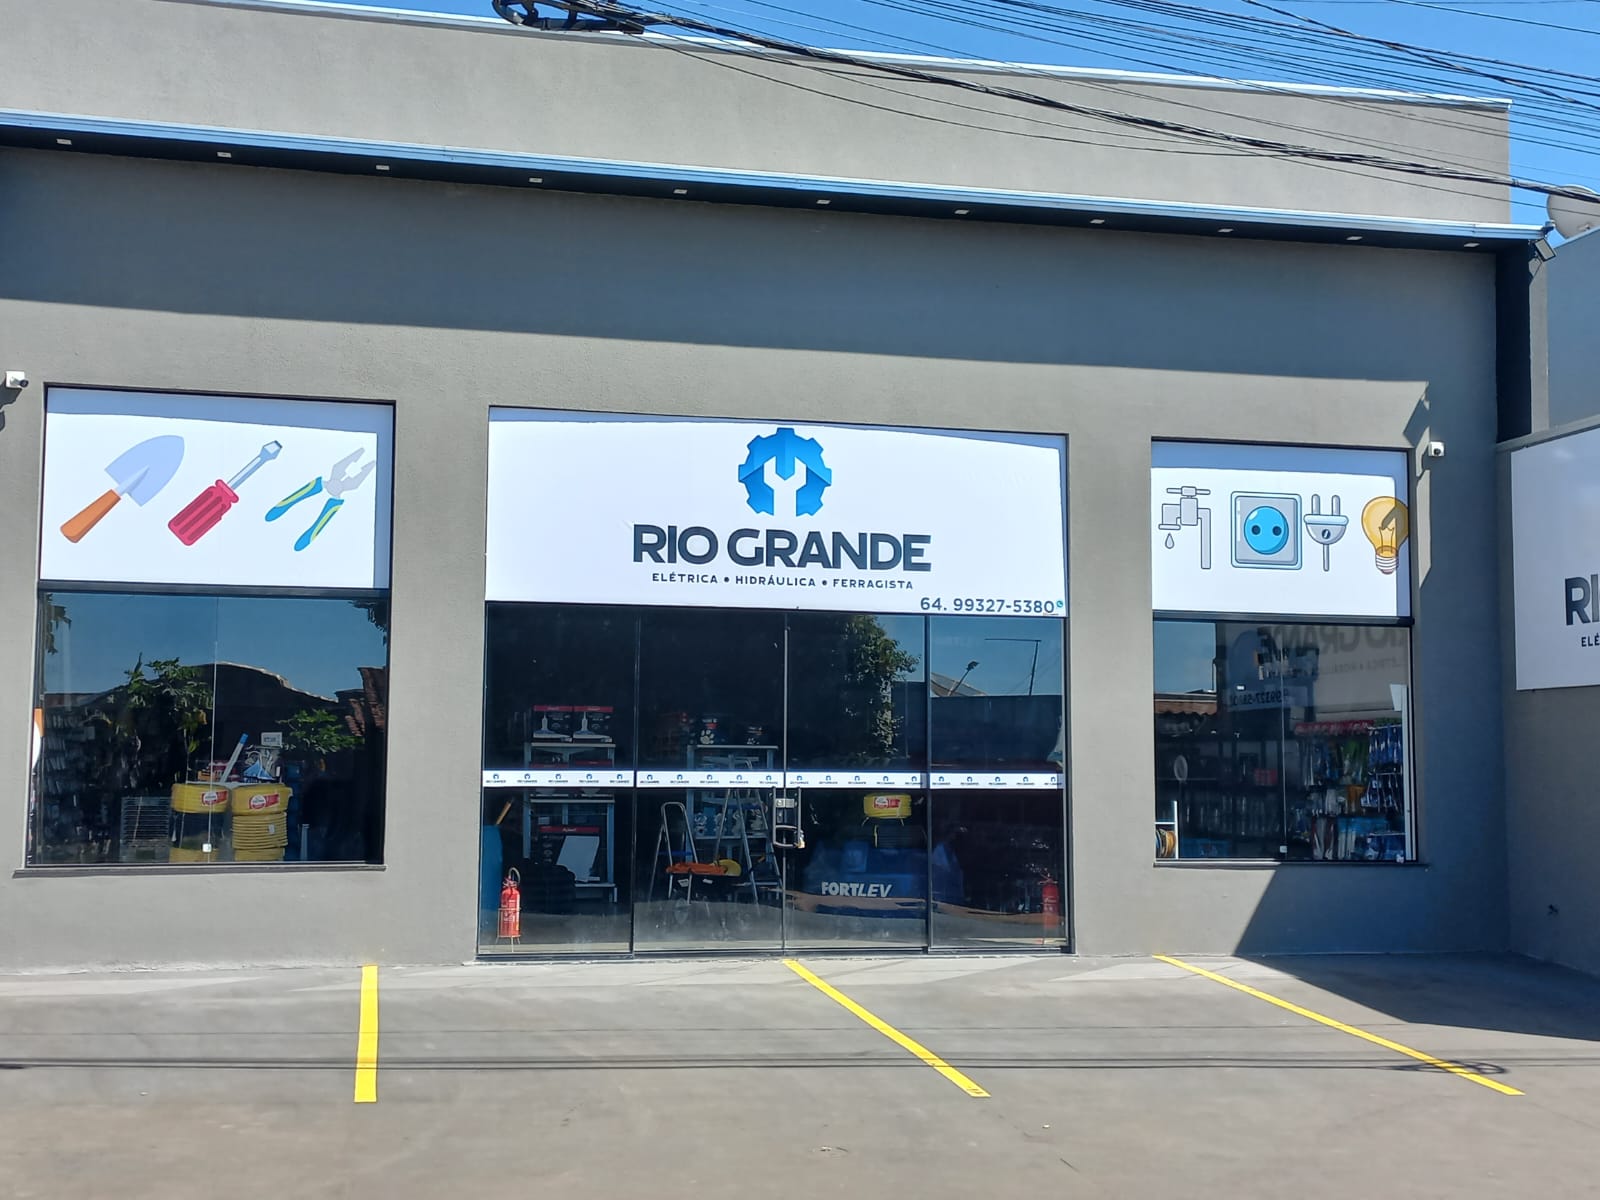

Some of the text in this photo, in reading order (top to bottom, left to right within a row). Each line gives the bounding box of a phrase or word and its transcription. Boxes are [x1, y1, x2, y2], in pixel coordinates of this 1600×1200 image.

[633, 524, 932, 572] RIO GRANDE
[652, 572, 913, 590] ELÉTRICA HIDRÁULICA FERRAGISTA
[920, 597, 1055, 614] 64. 99327-5380
[822, 881, 892, 898] FORTLEV
